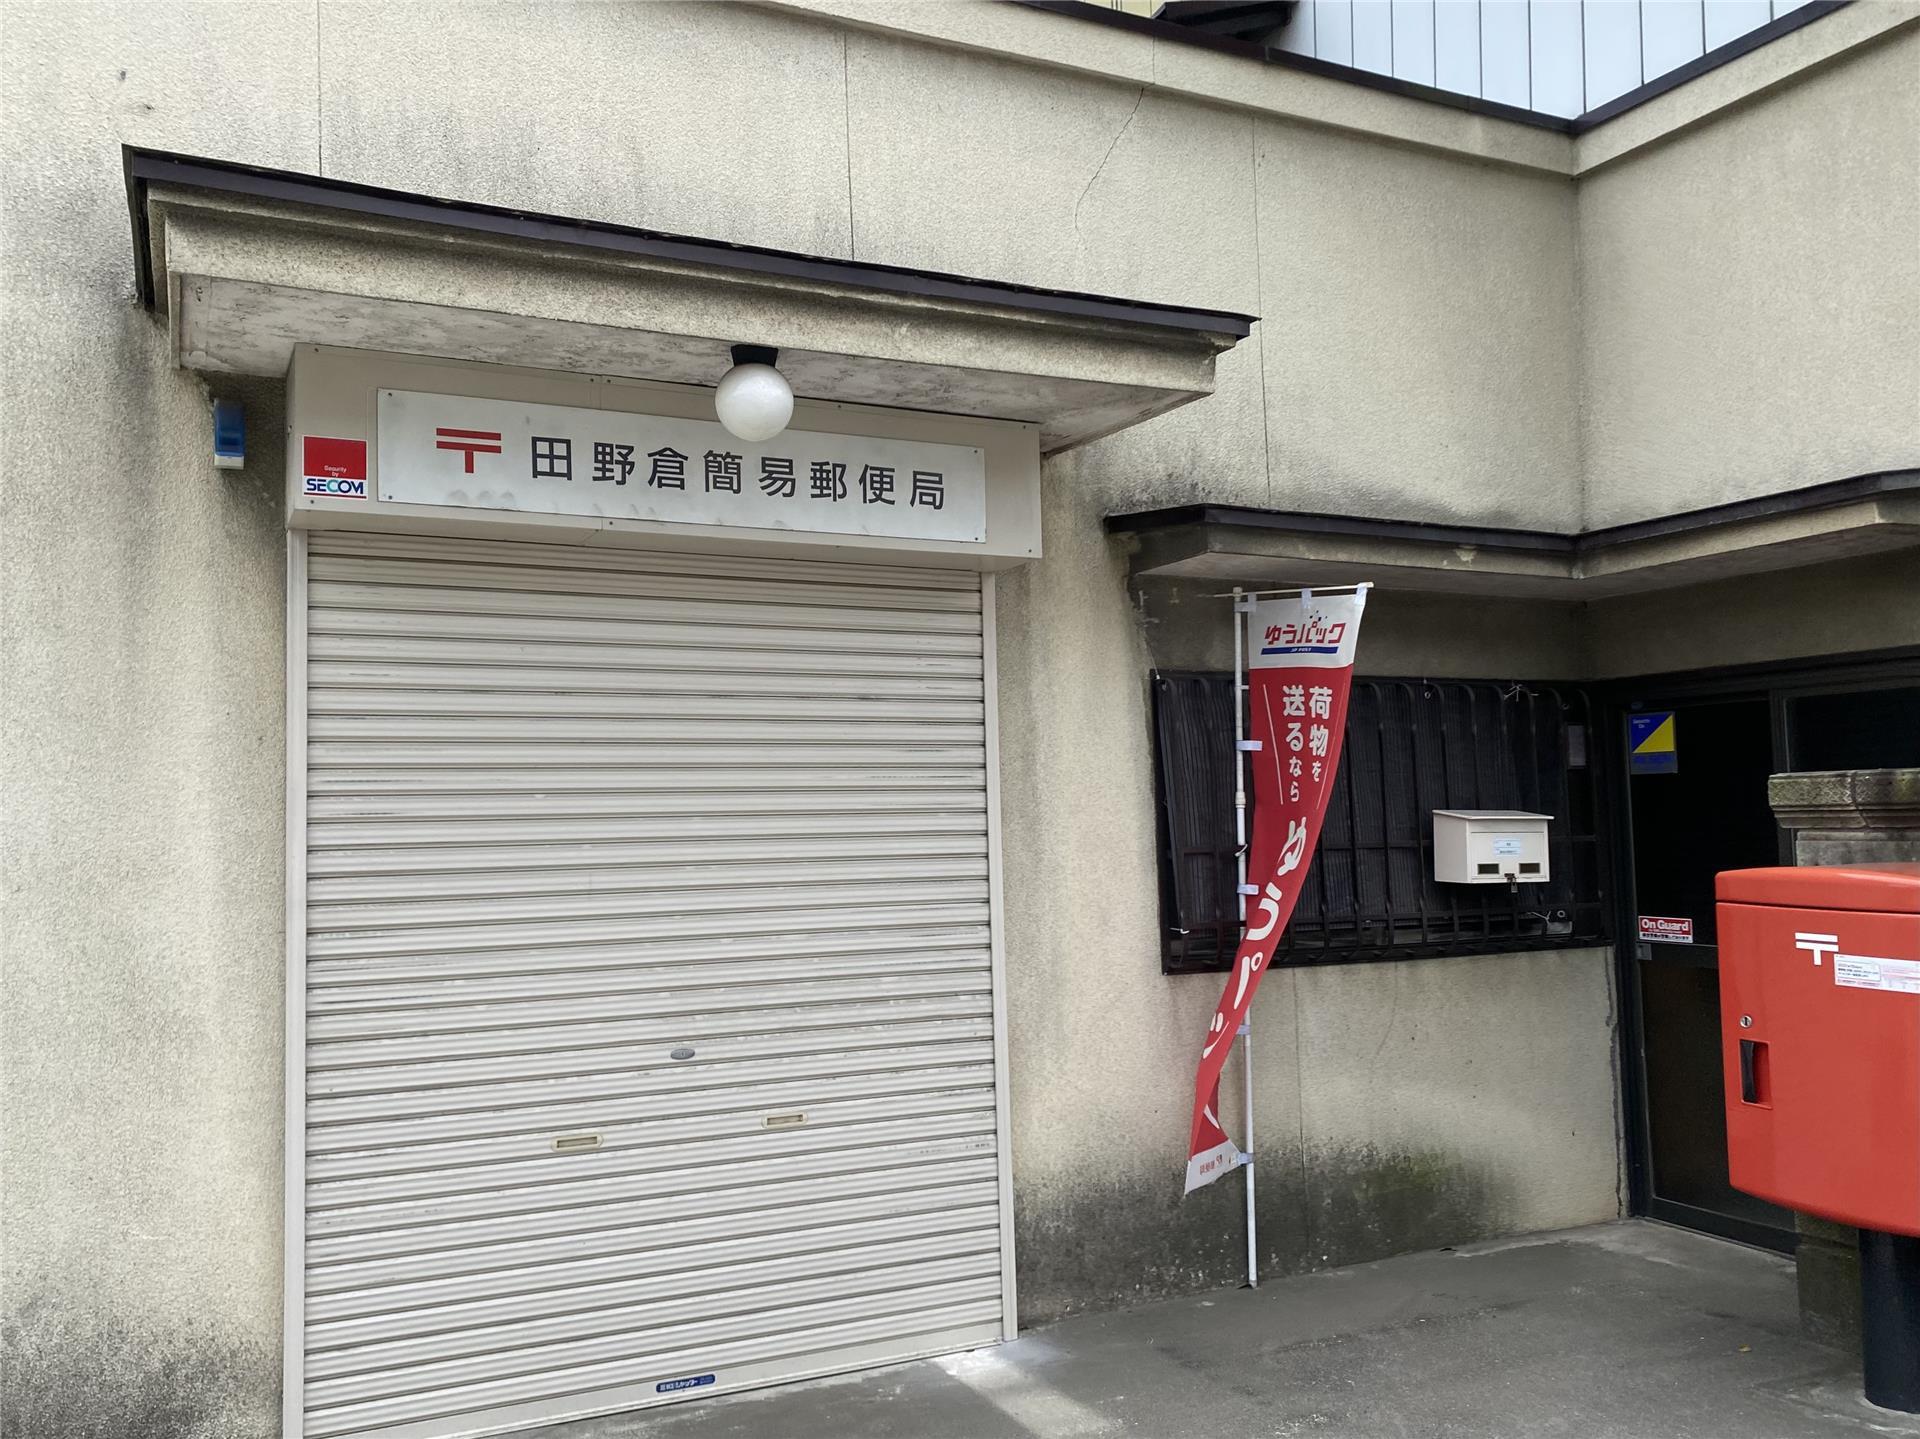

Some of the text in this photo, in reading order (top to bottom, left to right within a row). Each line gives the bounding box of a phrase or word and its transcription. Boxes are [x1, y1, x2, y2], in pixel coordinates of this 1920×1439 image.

[306, 478, 364, 494] SECOM
[531, 435, 945, 510] 田野倉簡易郵便局
[1264, 620, 1346, 645] ゆうパック
[1282, 684, 1306, 802] 送るなら
[1308, 686, 1333, 782] 荷物を
[1641, 918, 1689, 931] On Guard
